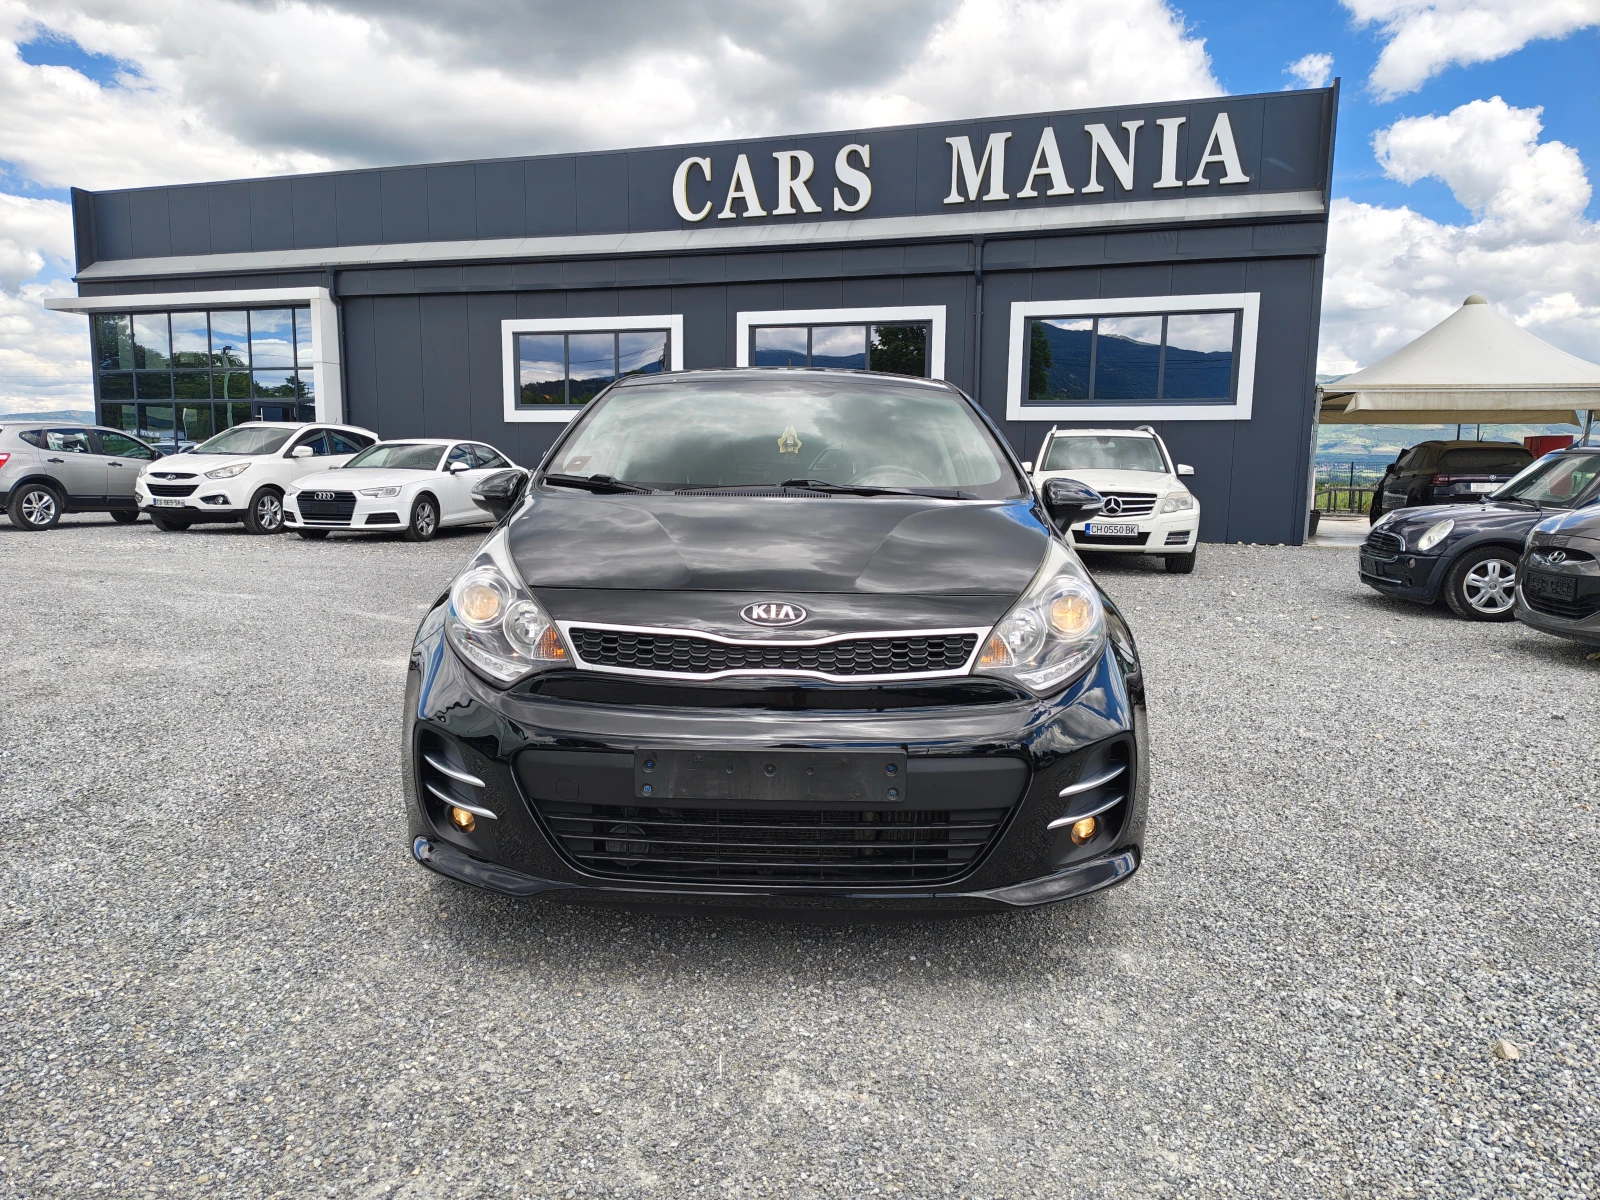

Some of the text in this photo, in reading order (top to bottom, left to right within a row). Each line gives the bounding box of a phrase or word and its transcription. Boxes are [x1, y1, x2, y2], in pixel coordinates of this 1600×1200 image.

[672, 112, 1250, 222] CARS MANIA
[1091, 525, 1136, 535] CH 0550 BK
[752, 604, 796, 620] KIA
